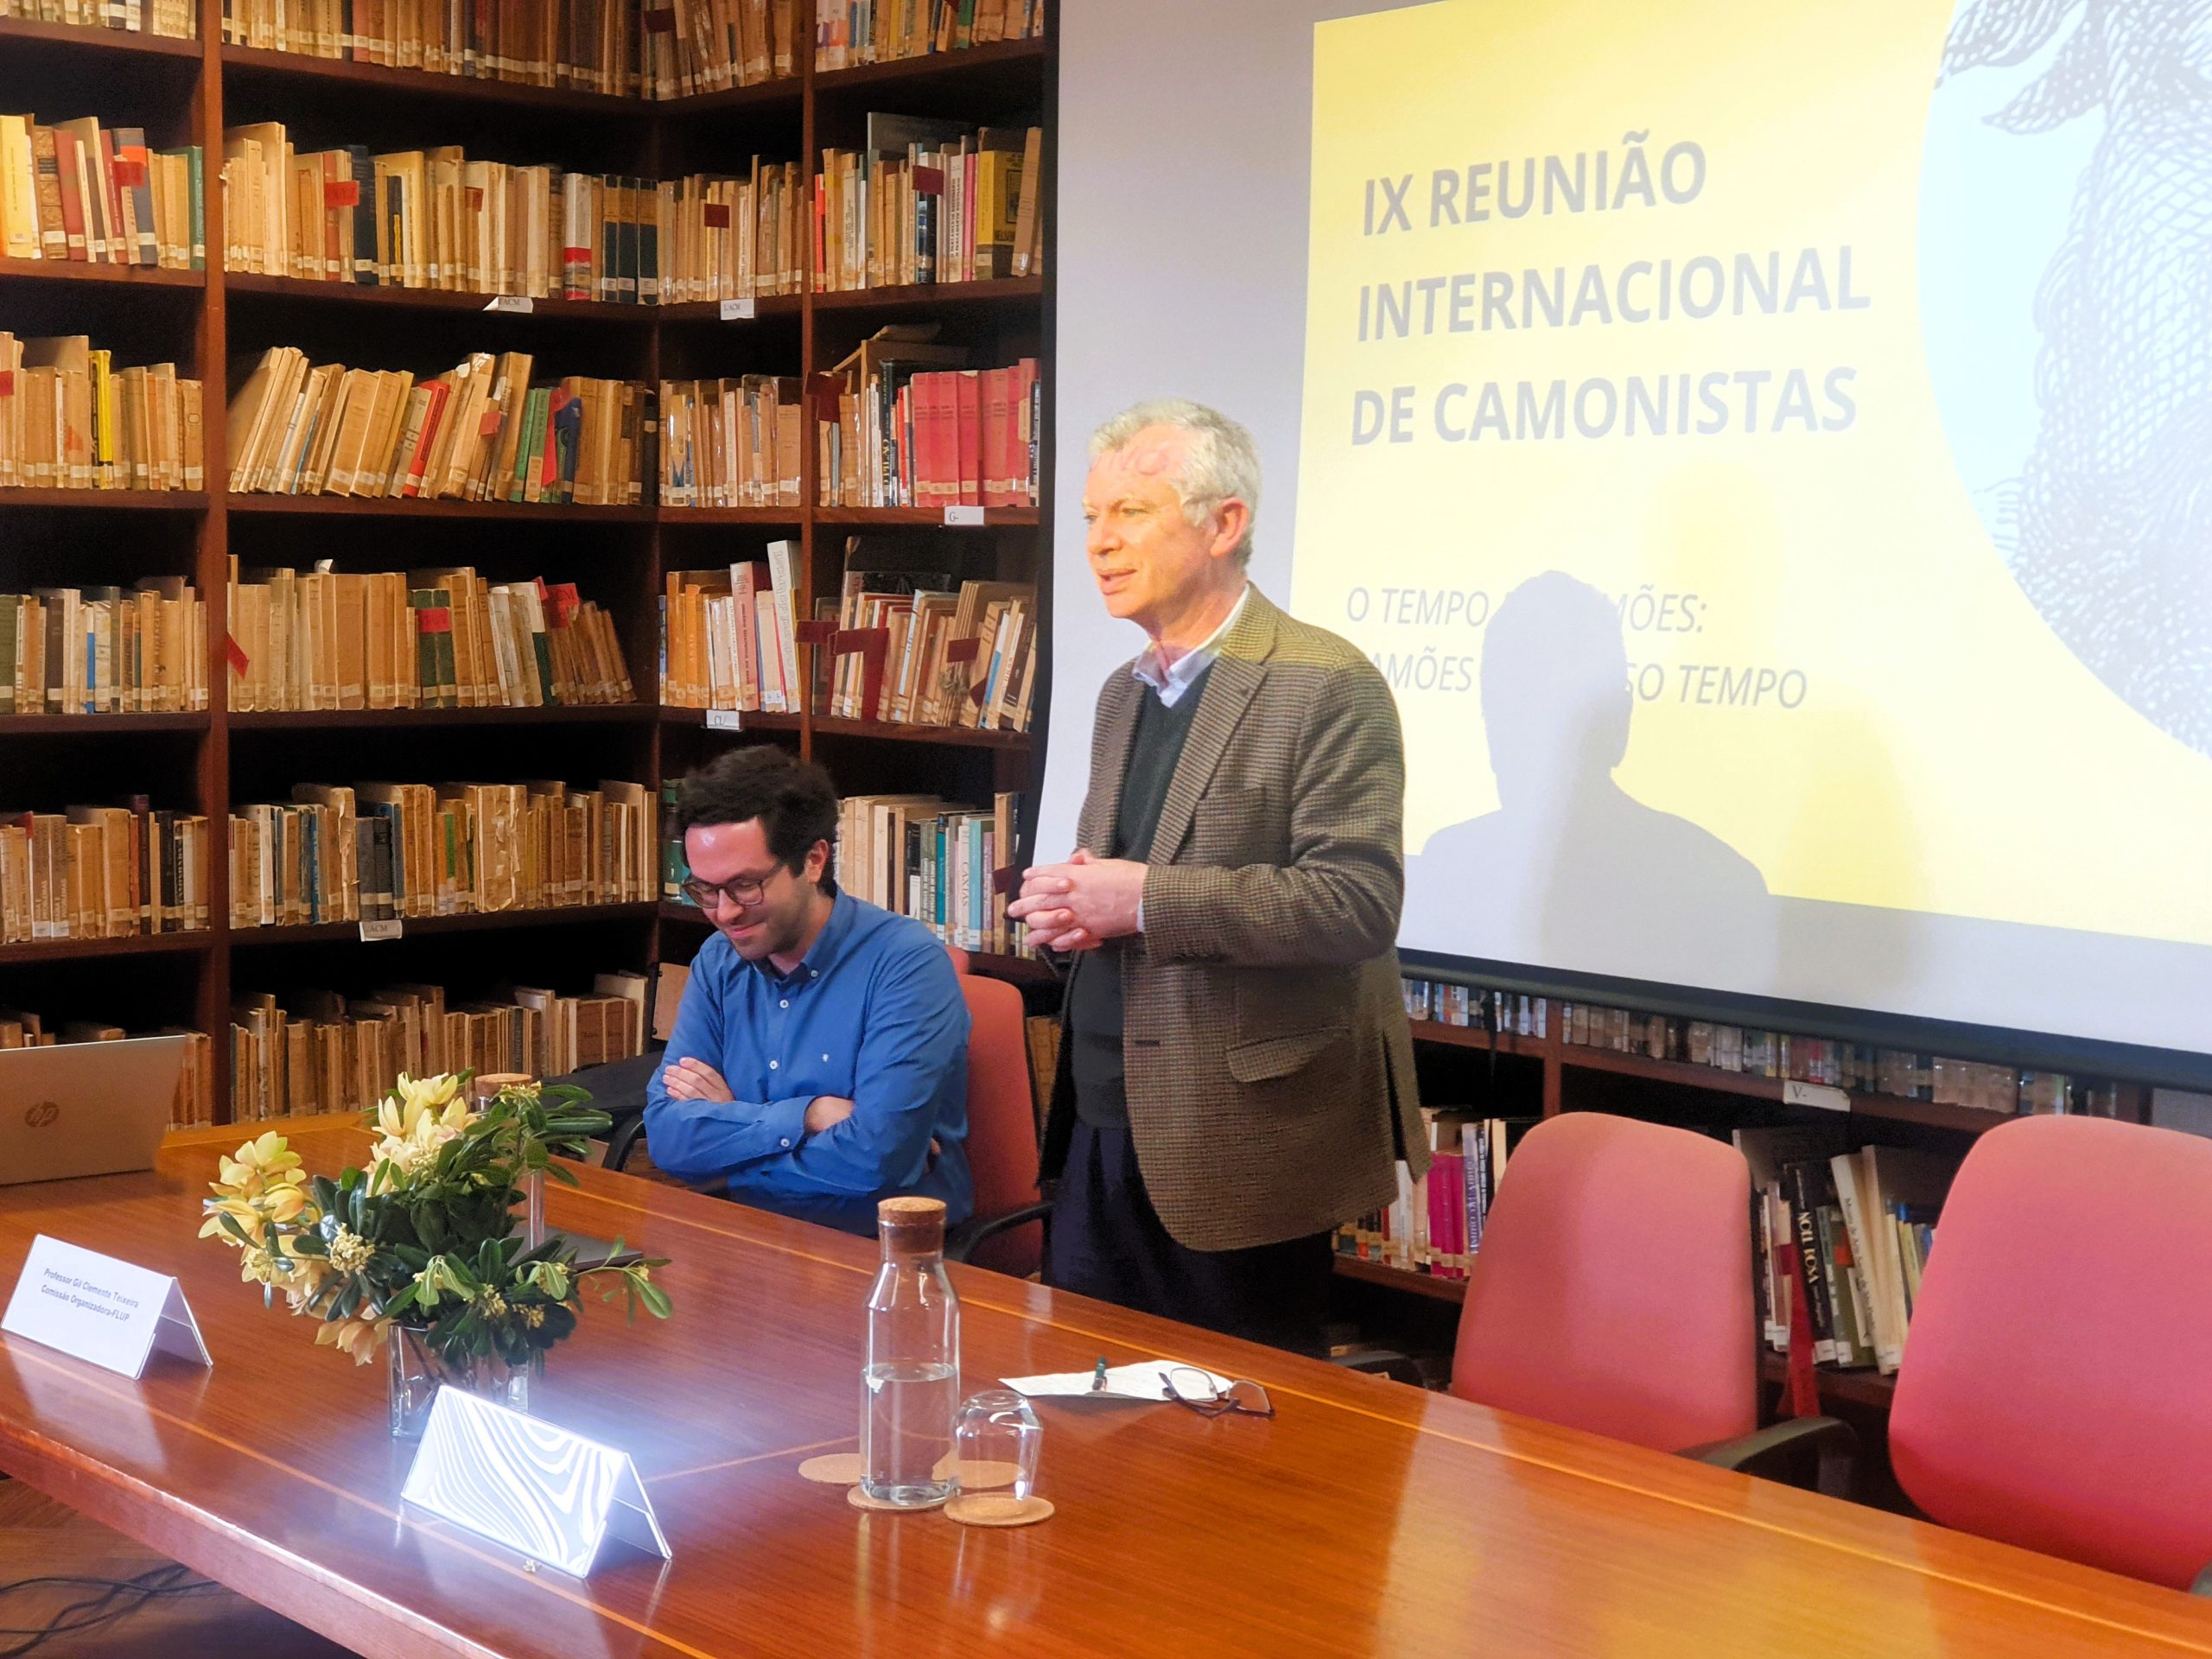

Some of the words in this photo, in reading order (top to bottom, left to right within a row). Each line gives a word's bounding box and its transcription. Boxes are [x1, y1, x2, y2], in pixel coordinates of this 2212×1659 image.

[1363, 173, 1414, 237] IX
[1429, 129, 1707, 228] REUNIÃO
[1357, 245, 1872, 342] INTERNACIONAL
[1351, 385, 1415, 446] DE
[1433, 366, 1859, 442] CAMONISTAS
[1347, 587, 1370, 622] O
[1381, 588, 1489, 627] TEMPO
[1678, 664, 1808, 709] TEMPO
[41, 1284, 70, 1301] Comissão
[43, 1268, 73, 1285] Professor
[112, 1292, 139, 1308] Teixeira
